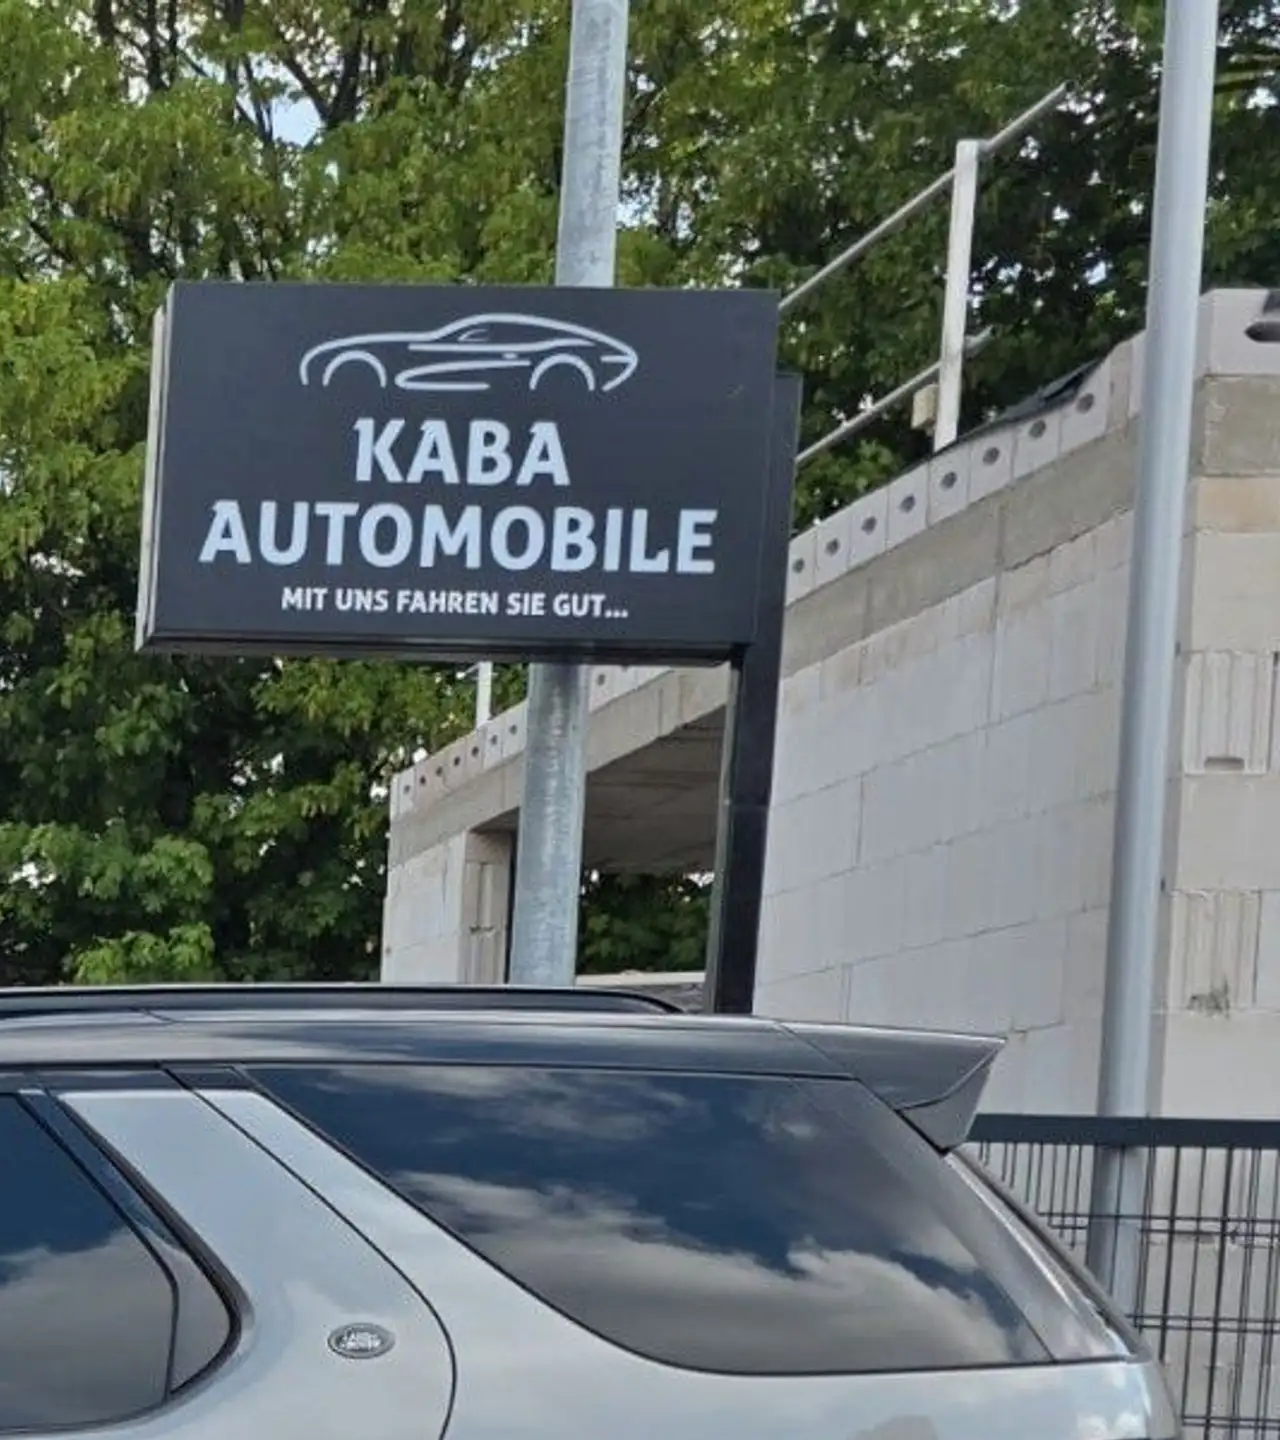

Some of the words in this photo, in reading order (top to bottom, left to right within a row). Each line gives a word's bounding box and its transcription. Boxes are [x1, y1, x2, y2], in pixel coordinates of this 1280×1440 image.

[353, 416, 570, 486] KABA
[198, 498, 719, 575] AUTOMOBILE
[281, 585, 329, 611] MIT
[334, 586, 389, 612] UNS
[396, 588, 499, 615] FAHREN
[505, 591, 546, 617] SIE
[552, 591, 629, 618] GUT...
